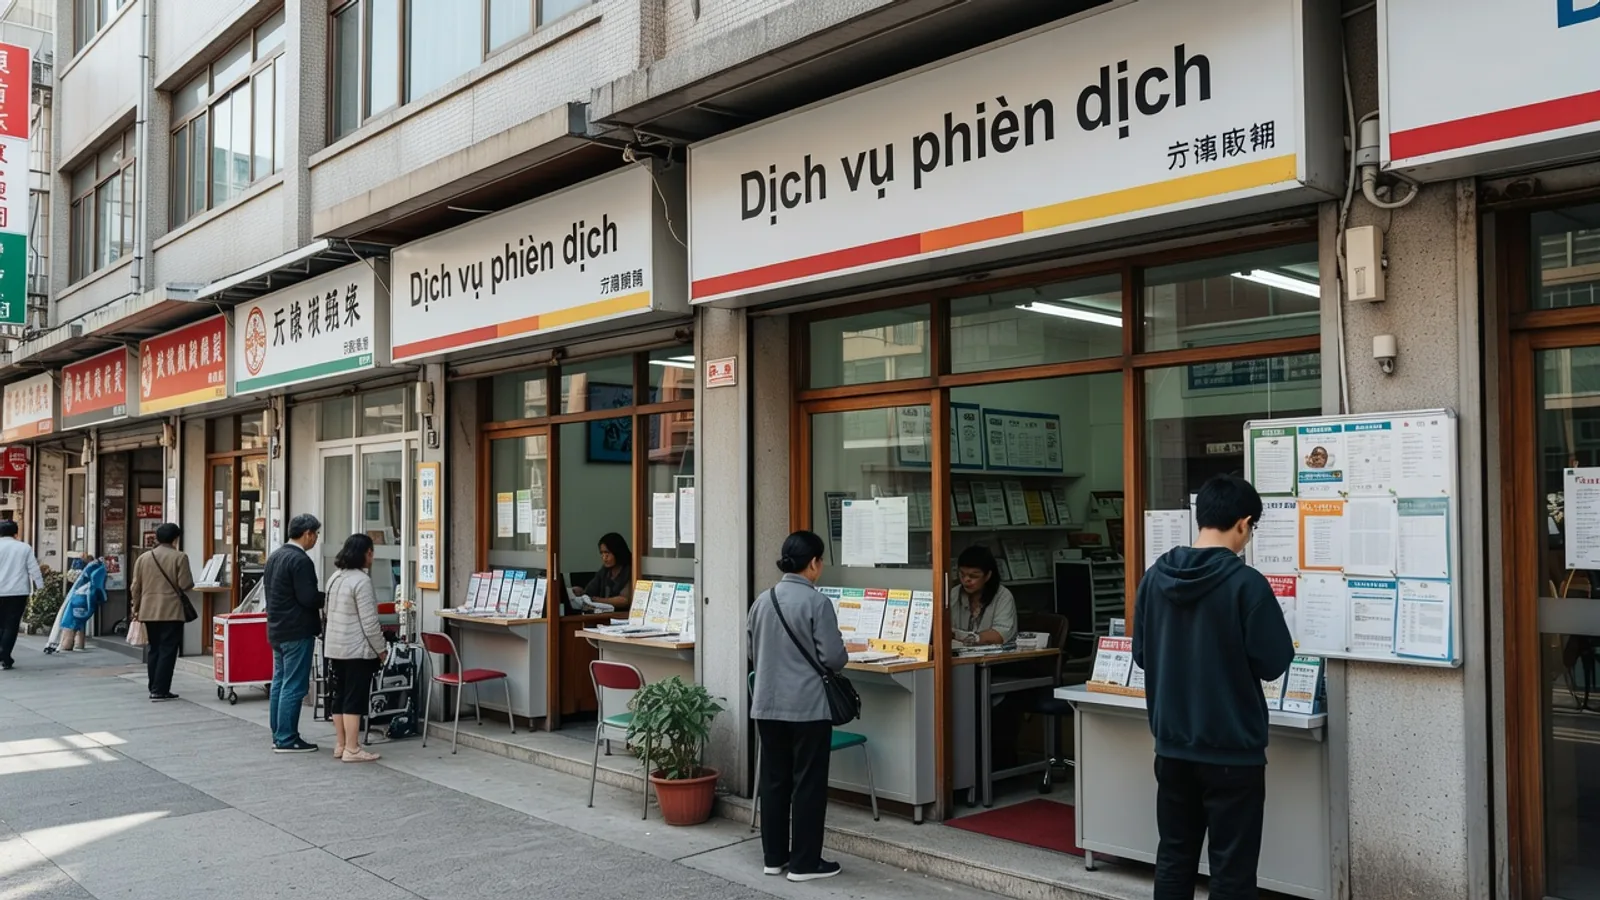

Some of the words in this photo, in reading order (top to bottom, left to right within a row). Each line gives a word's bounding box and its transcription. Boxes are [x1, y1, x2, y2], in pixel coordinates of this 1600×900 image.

[741, 154, 827, 224] Dịch
[841, 143, 894, 199] vụ
[912, 95, 1055, 190] phièn
[1076, 44, 1211, 139] dịch
[410, 263, 452, 312] Dịch
[458, 262, 483, 300] vụ
[491, 234, 554, 295] phièn
[562, 213, 618, 273] dịch
